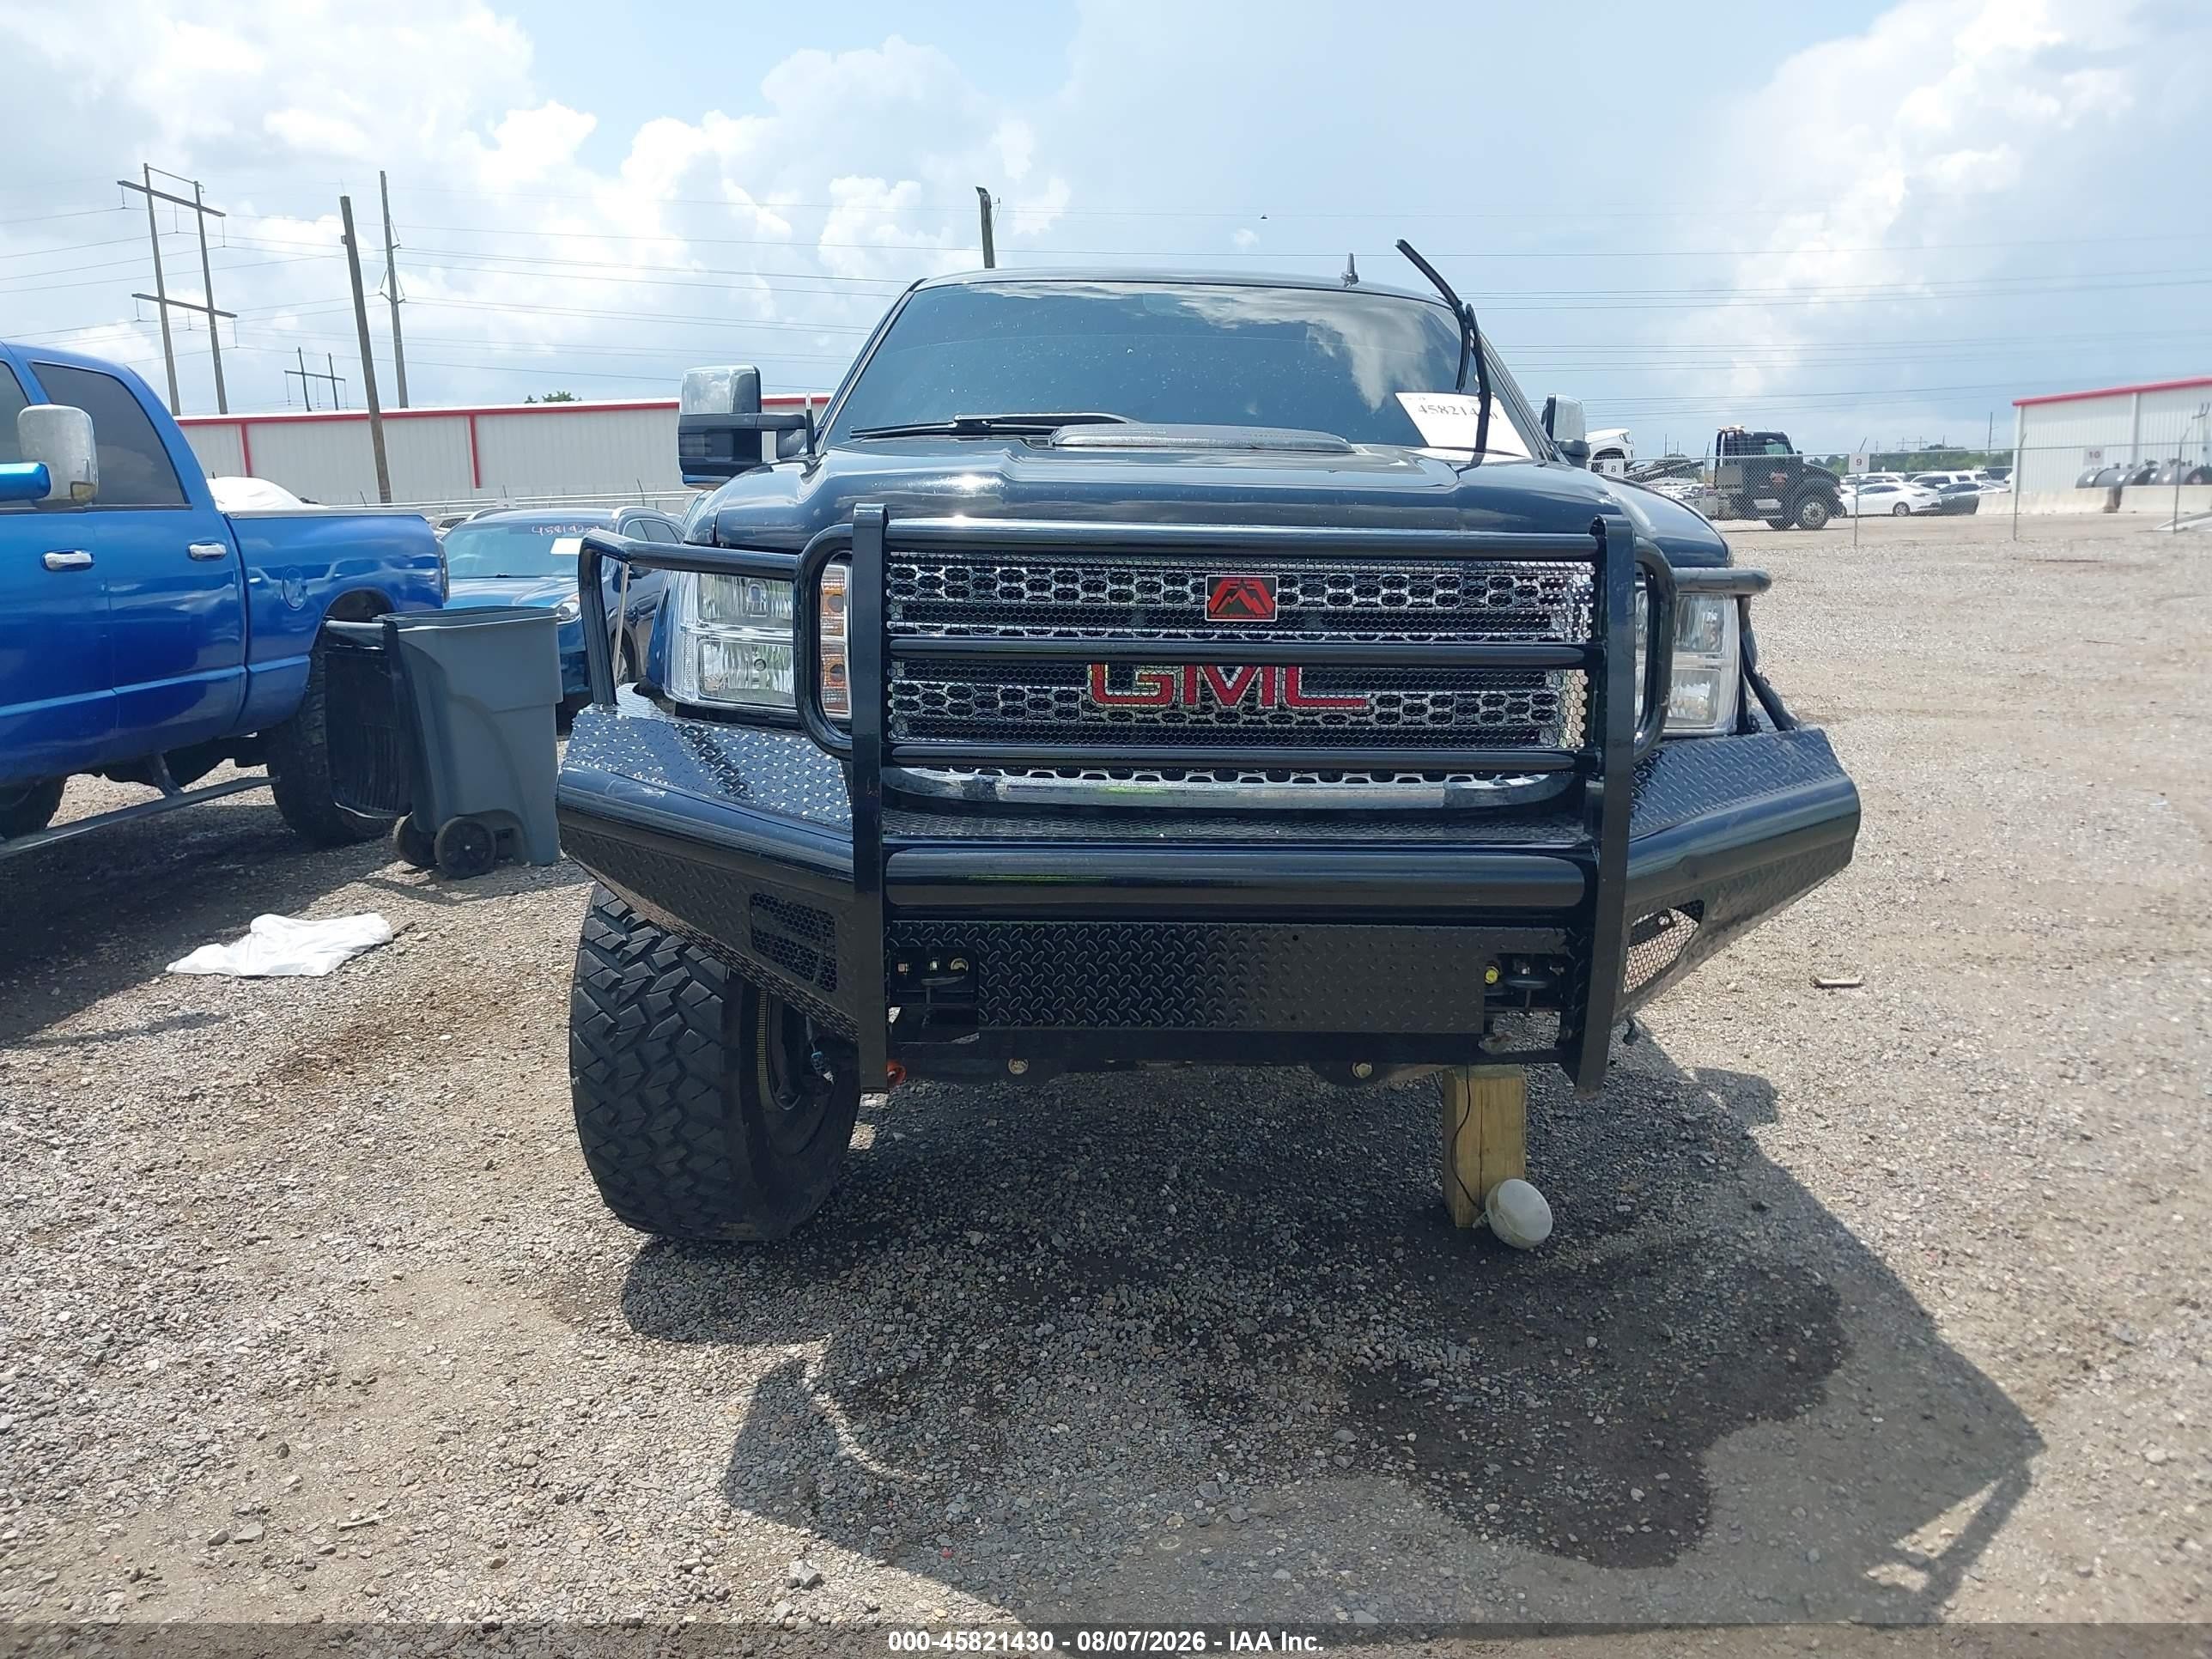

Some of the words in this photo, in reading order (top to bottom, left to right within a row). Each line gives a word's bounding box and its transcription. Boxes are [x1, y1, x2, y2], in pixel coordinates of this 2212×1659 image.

[1417, 404, 1498, 420] 4582140
[1856, 458, 1863, 466] 9
[1610, 465, 1617, 473] 8
[1087, 663, 1371, 710] GMC
